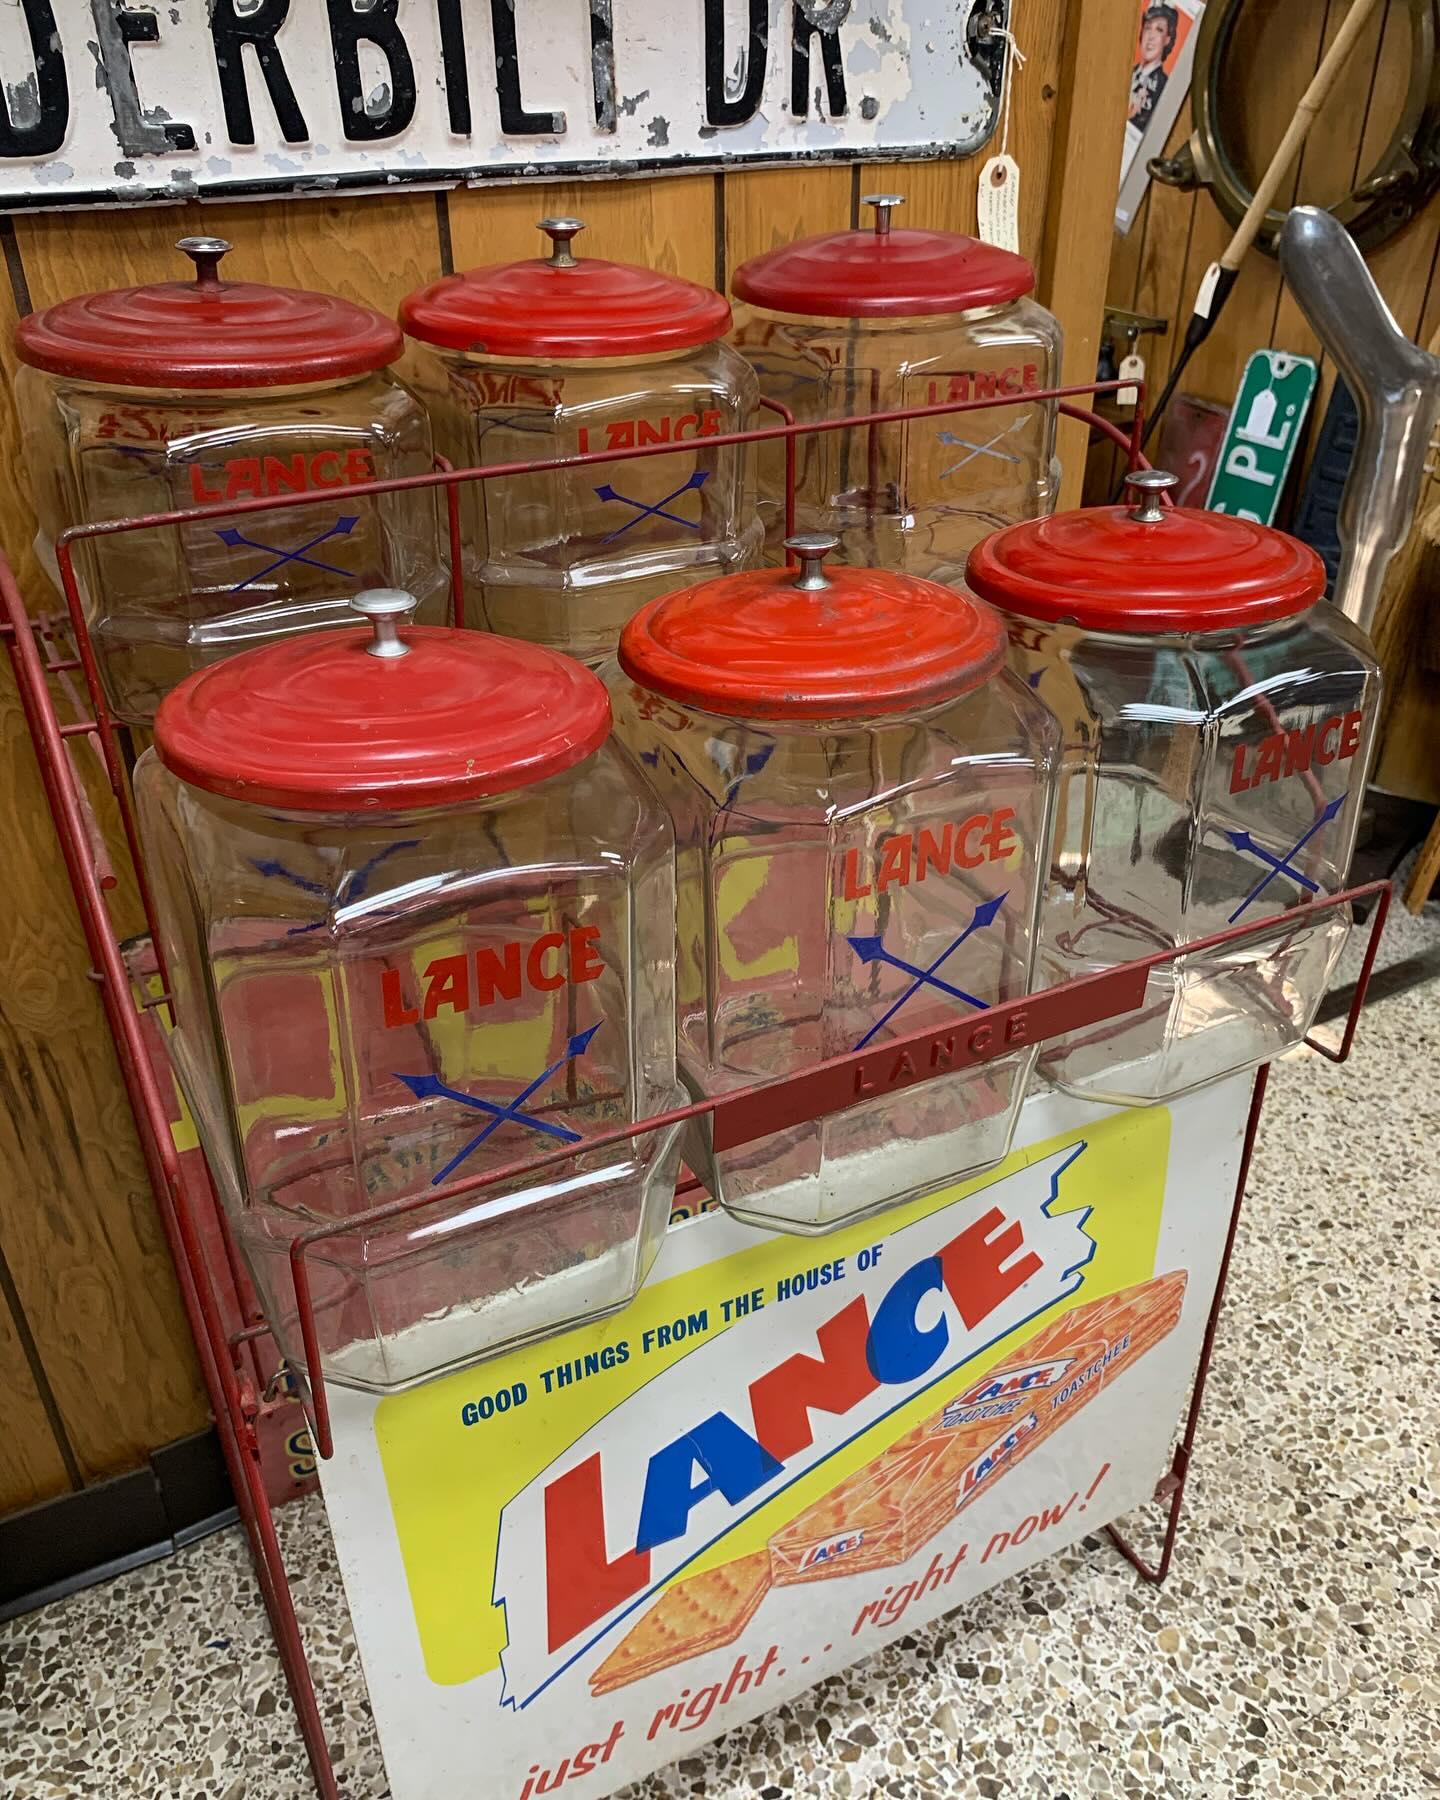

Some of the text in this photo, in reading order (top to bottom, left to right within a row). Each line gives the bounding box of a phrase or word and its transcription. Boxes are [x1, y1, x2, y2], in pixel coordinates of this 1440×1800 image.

[189, 447, 376, 502] LANCE
[1229, 710, 1363, 795] LANCE
[842, 807, 1018, 901] LANCE
[380, 925, 606, 1028] LANCE
[853, 1010, 1029, 1096] LANCE
[461, 1243, 883, 1426] GOOD THINGS FROM THE HOUSE OF
[1052, 1334, 1131, 1409] TOASTCHEE
[544, 1206, 1044, 1655] LANCE
[957, 1366, 1056, 1405] LANCE
[520, 1720, 624, 1800] just
[852, 1544, 968, 1635] right
[980, 1463, 1111, 1563] now!
